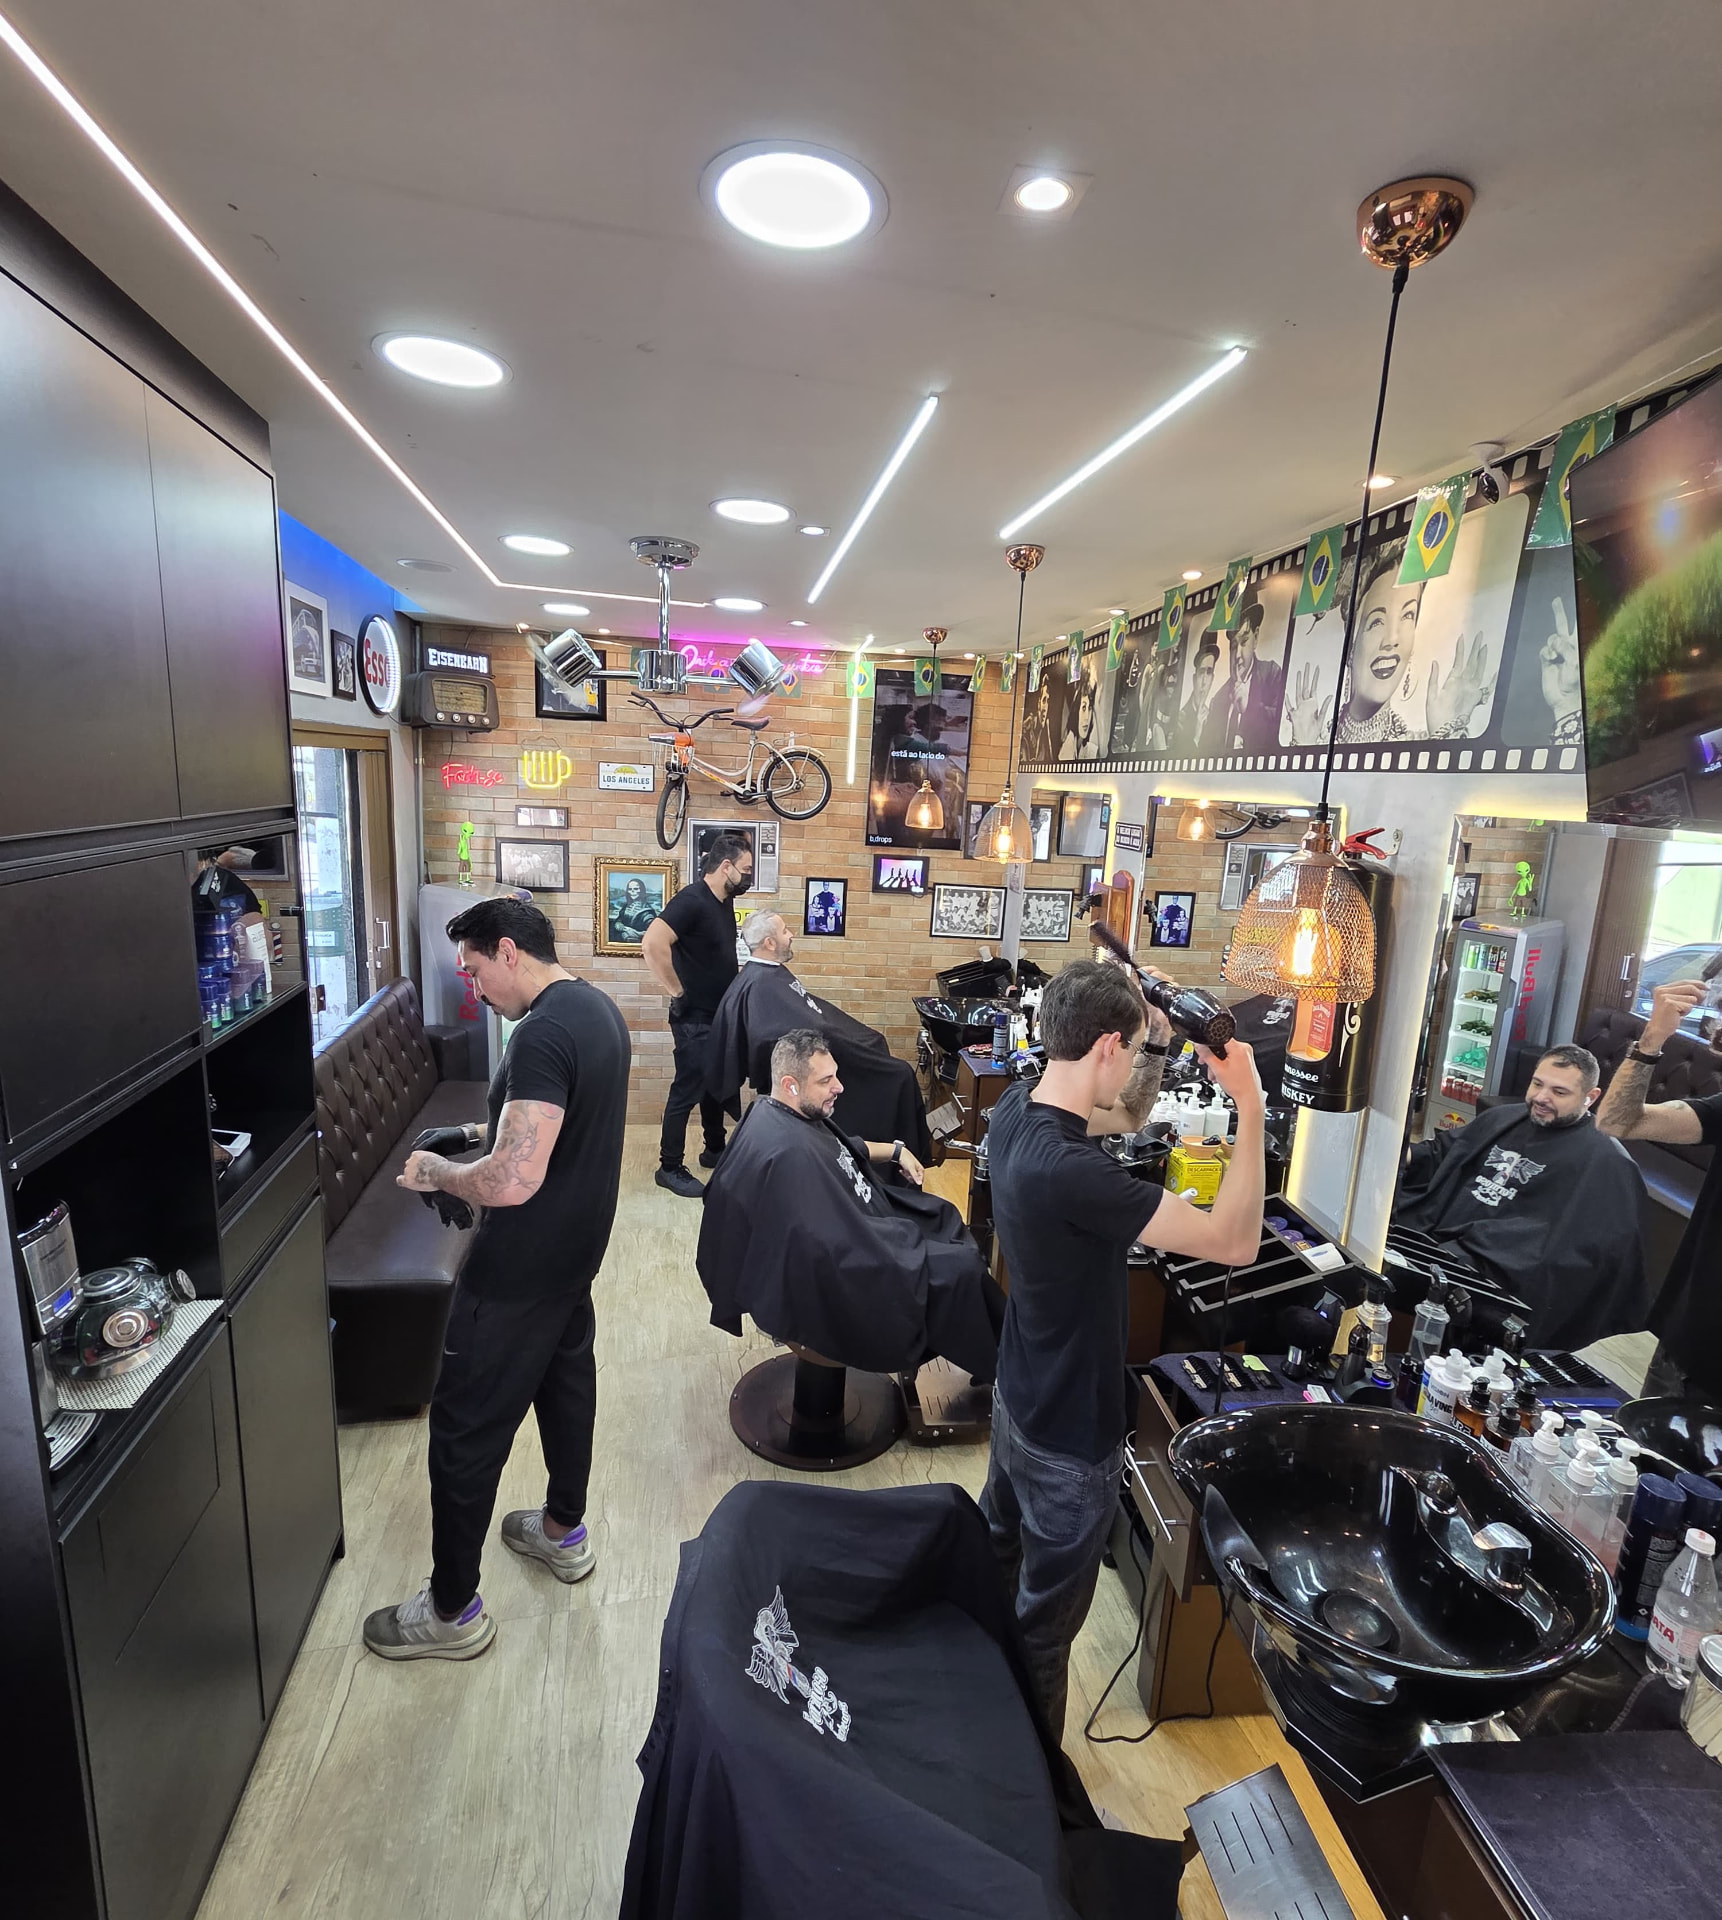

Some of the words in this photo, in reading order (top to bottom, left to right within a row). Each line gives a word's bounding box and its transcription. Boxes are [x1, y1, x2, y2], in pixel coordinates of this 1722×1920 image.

[428, 648, 488, 674] EISENBAHN
[891, 750, 908, 758] está
[935, 752, 945, 760] do
[602, 775, 617, 783] LOS
[618, 776, 650, 785] ANGELES
[1452, 1417, 1472, 1436] URE
[1652, 1615, 1675, 1644] ATA
